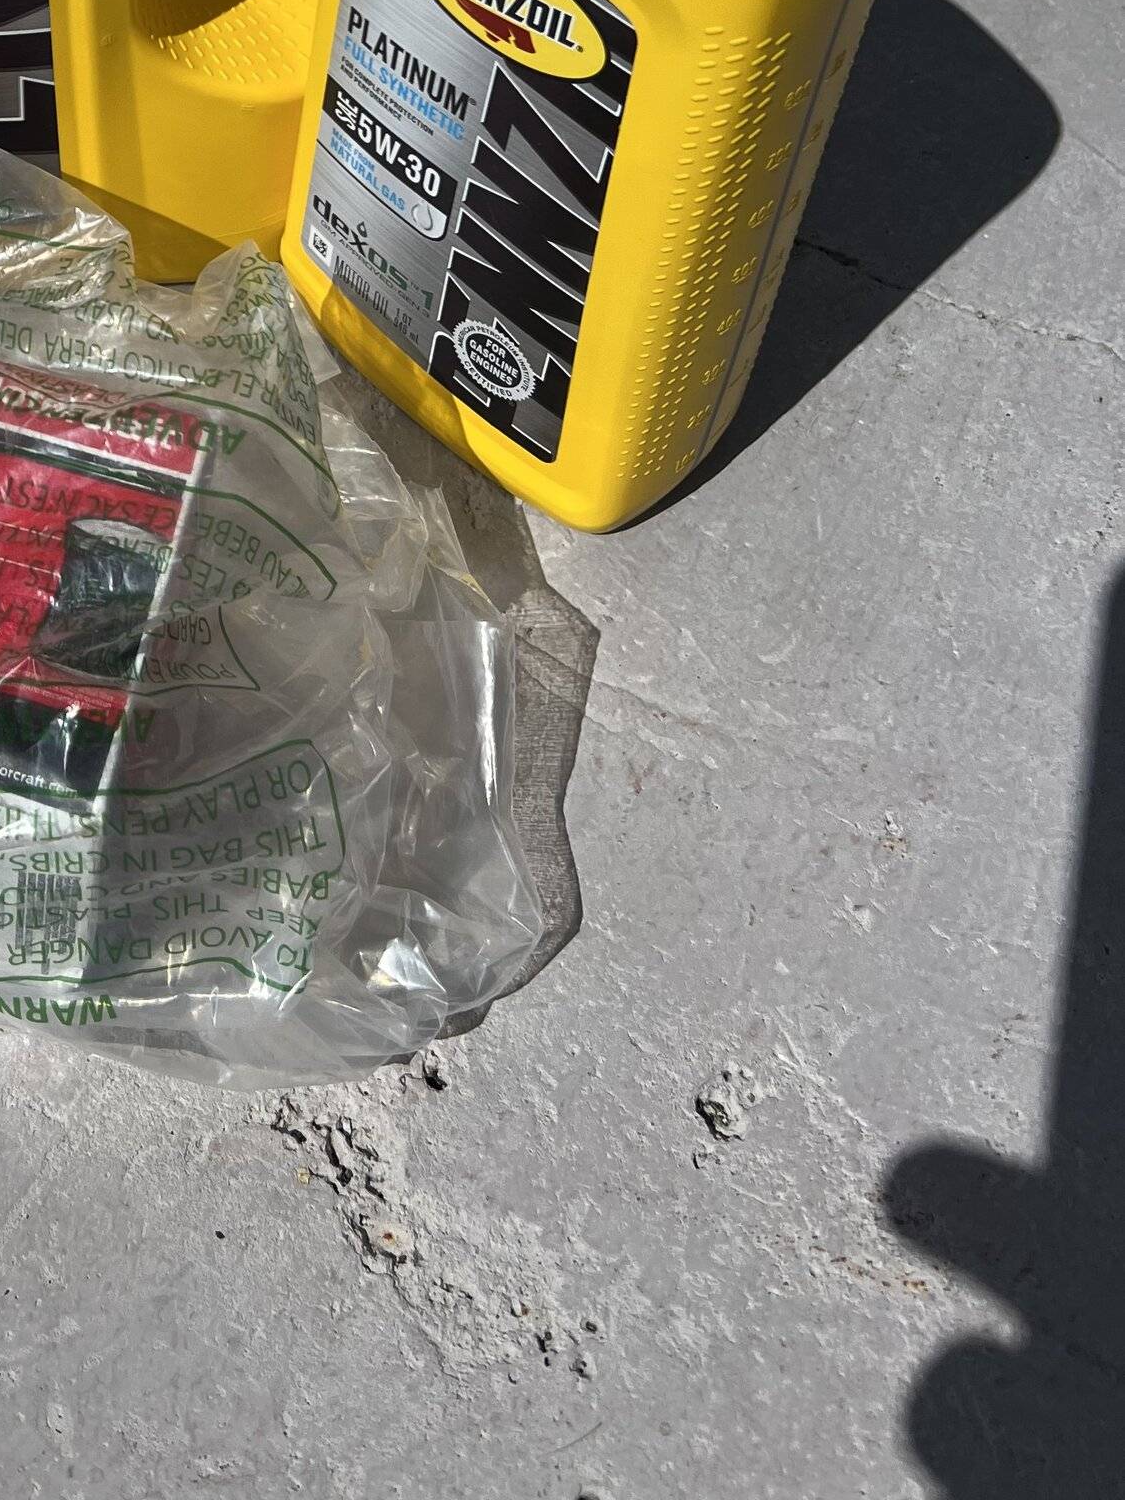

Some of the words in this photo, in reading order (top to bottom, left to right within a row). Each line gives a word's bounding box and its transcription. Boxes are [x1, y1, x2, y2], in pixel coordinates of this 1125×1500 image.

[343, 35, 376, 76] FULL
[378, 65, 466, 142] SYNTHETIC
[354, 64, 390, 102] COMPLETE
[388, 95, 435, 137] PROTECTION
[335, 90, 359, 132] SAE
[332, 127, 353, 150] MADE
[353, 145, 375, 171] FROM
[357, 110, 441, 198] 5W-30
[329, 136, 380, 192] NATURAL
[380, 182, 406, 212] GAS
[332, 255, 372, 302] MOTOR
[372, 290, 389, 319] OIL
[469, 339, 519, 379] GASOLINE
[469, 350, 513, 386] ENGINES
[485, 338, 506, 359] FOR
[264, 759, 313, 801] OR
[182, 774, 262, 829] PLAY
[169, 837, 244, 870] BAG
[254, 815, 328, 859] THIS
[123, 849, 158, 874] IN
[119, 874, 200, 897] AND
[210, 866, 330, 901] BABIES
[151, 892, 229, 920] THIS
[6, 935, 152, 967] DANGER
[163, 925, 274, 955] AVOID
